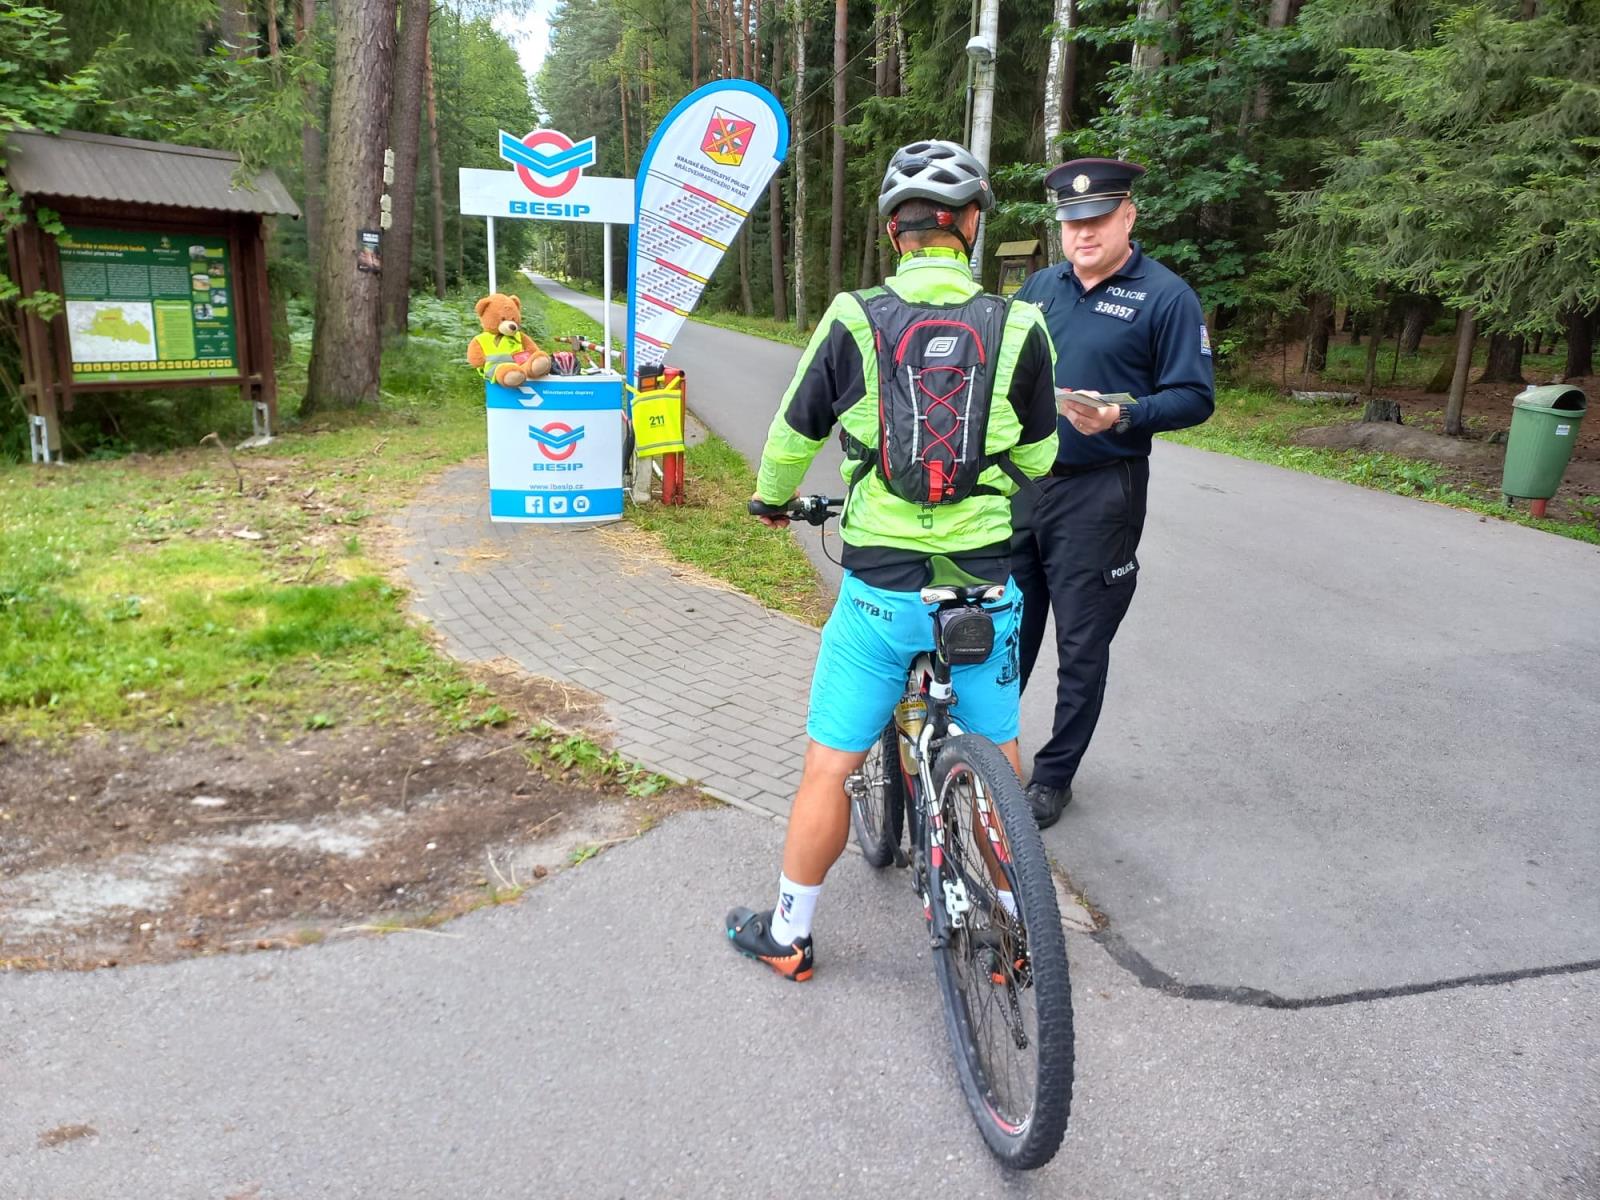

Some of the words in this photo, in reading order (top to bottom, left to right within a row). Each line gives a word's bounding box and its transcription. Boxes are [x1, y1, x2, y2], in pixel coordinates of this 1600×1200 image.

[509, 200, 590, 217] BESIP
[1106, 285, 1148, 301] POLICIE
[1095, 301, 1134, 318] 336357
[649, 415, 664, 425] 211
[533, 463, 583, 471] BESIP
